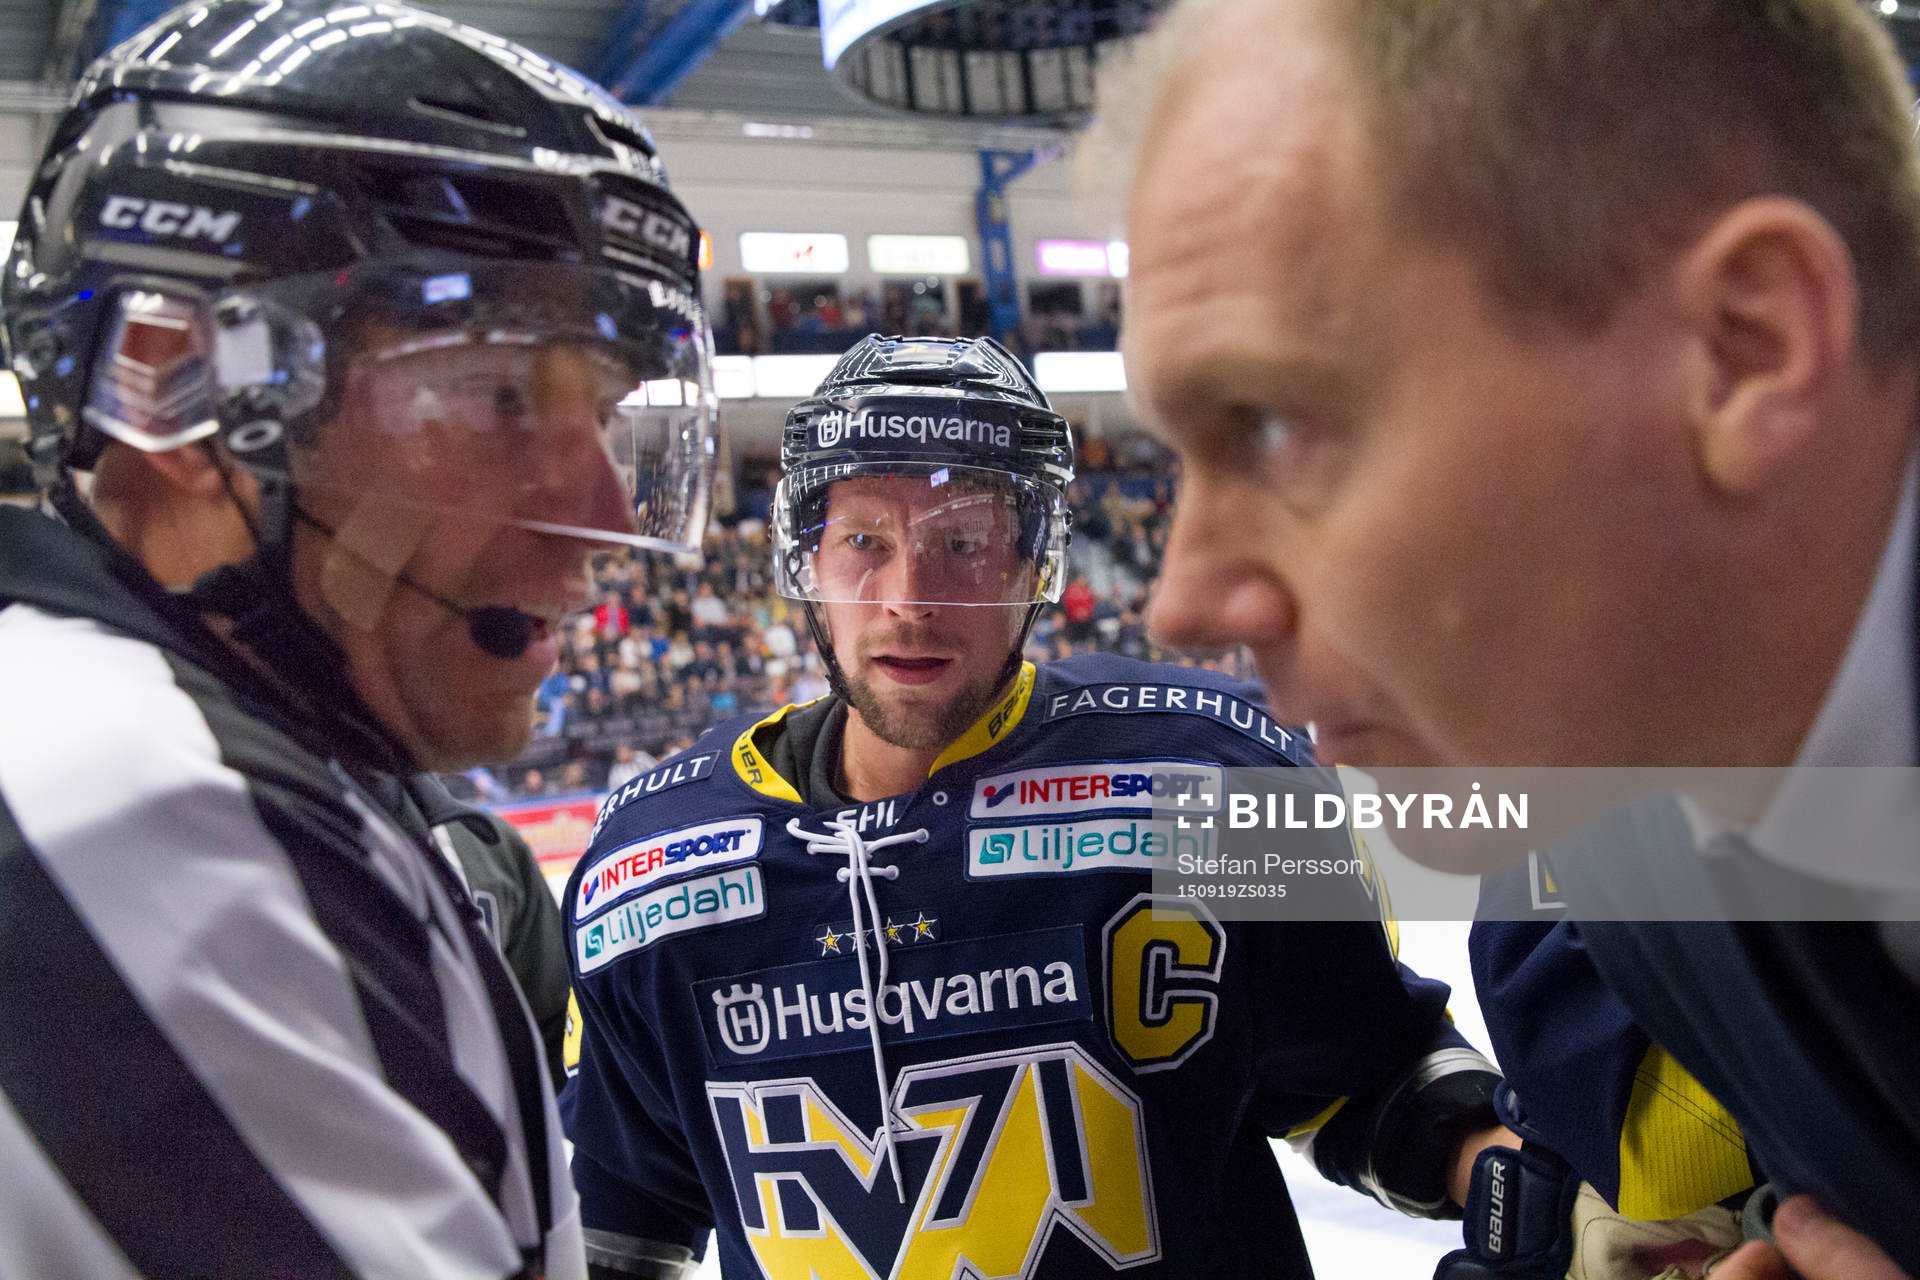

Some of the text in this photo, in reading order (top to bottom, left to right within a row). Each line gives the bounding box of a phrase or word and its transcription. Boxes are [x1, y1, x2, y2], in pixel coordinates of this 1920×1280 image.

[100, 196, 241, 242] CCM
[845, 409, 1011, 447] Husqvarna
[1050, 687, 1293, 751] FAGERHULT
[1020, 774, 1203, 804] INTERSPORT
[602, 831, 745, 892] INTERSPORT
[1022, 823, 1209, 868] Liljedahl
[607, 872, 755, 943] Liljedahl
[773, 961, 1079, 1040] Husqvarna
[1101, 893, 1227, 1073] C
[1488, 1160, 1506, 1253] BAUER
